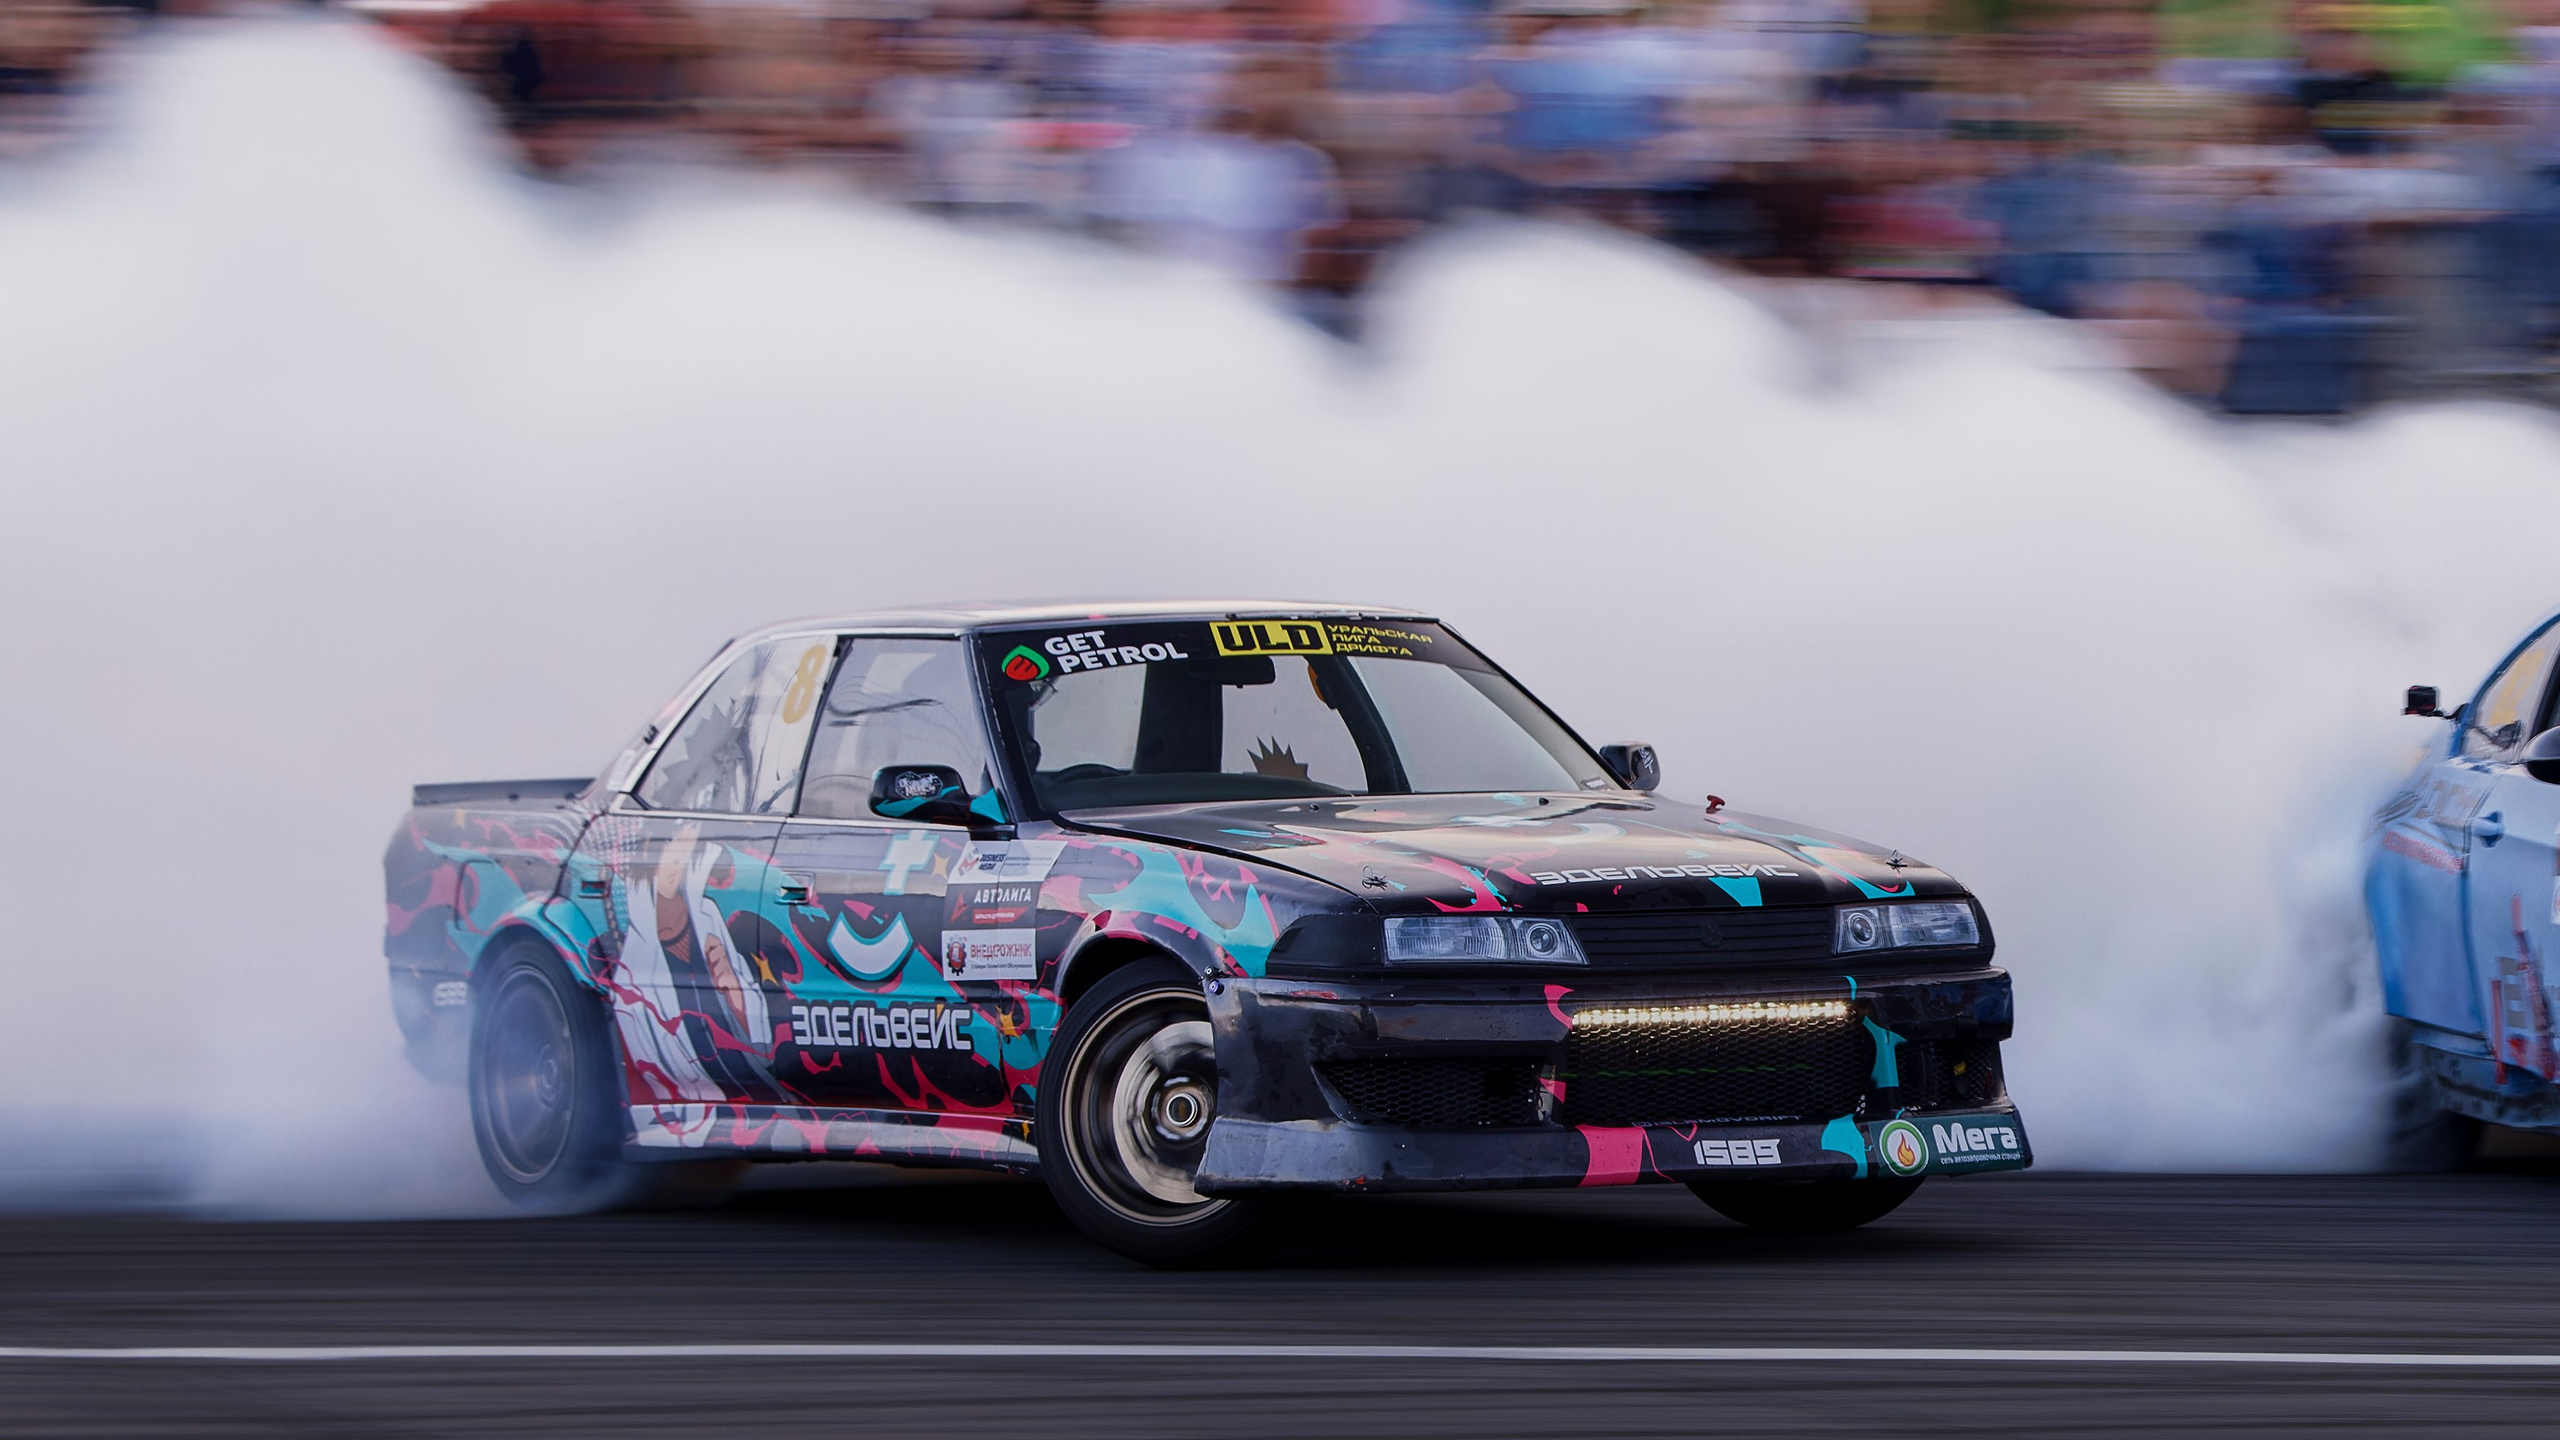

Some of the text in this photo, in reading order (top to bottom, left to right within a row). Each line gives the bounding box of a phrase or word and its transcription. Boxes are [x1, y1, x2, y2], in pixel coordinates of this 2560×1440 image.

[1044, 630, 1105, 656] GET
[1216, 622, 1324, 651] ULD
[1327, 624, 1432, 643] УРАЛЬСКАЯ
[1332, 633, 1381, 644] ЛИГА
[1056, 642, 1189, 674] PETROL
[1336, 643, 1413, 656] ДРИФТА
[782, 644, 828, 725] 8
[973, 887, 1031, 904] АВТОЛИГА
[1932, 1122, 2018, 1154] Мега
[1693, 1138, 1782, 1165] 1589
